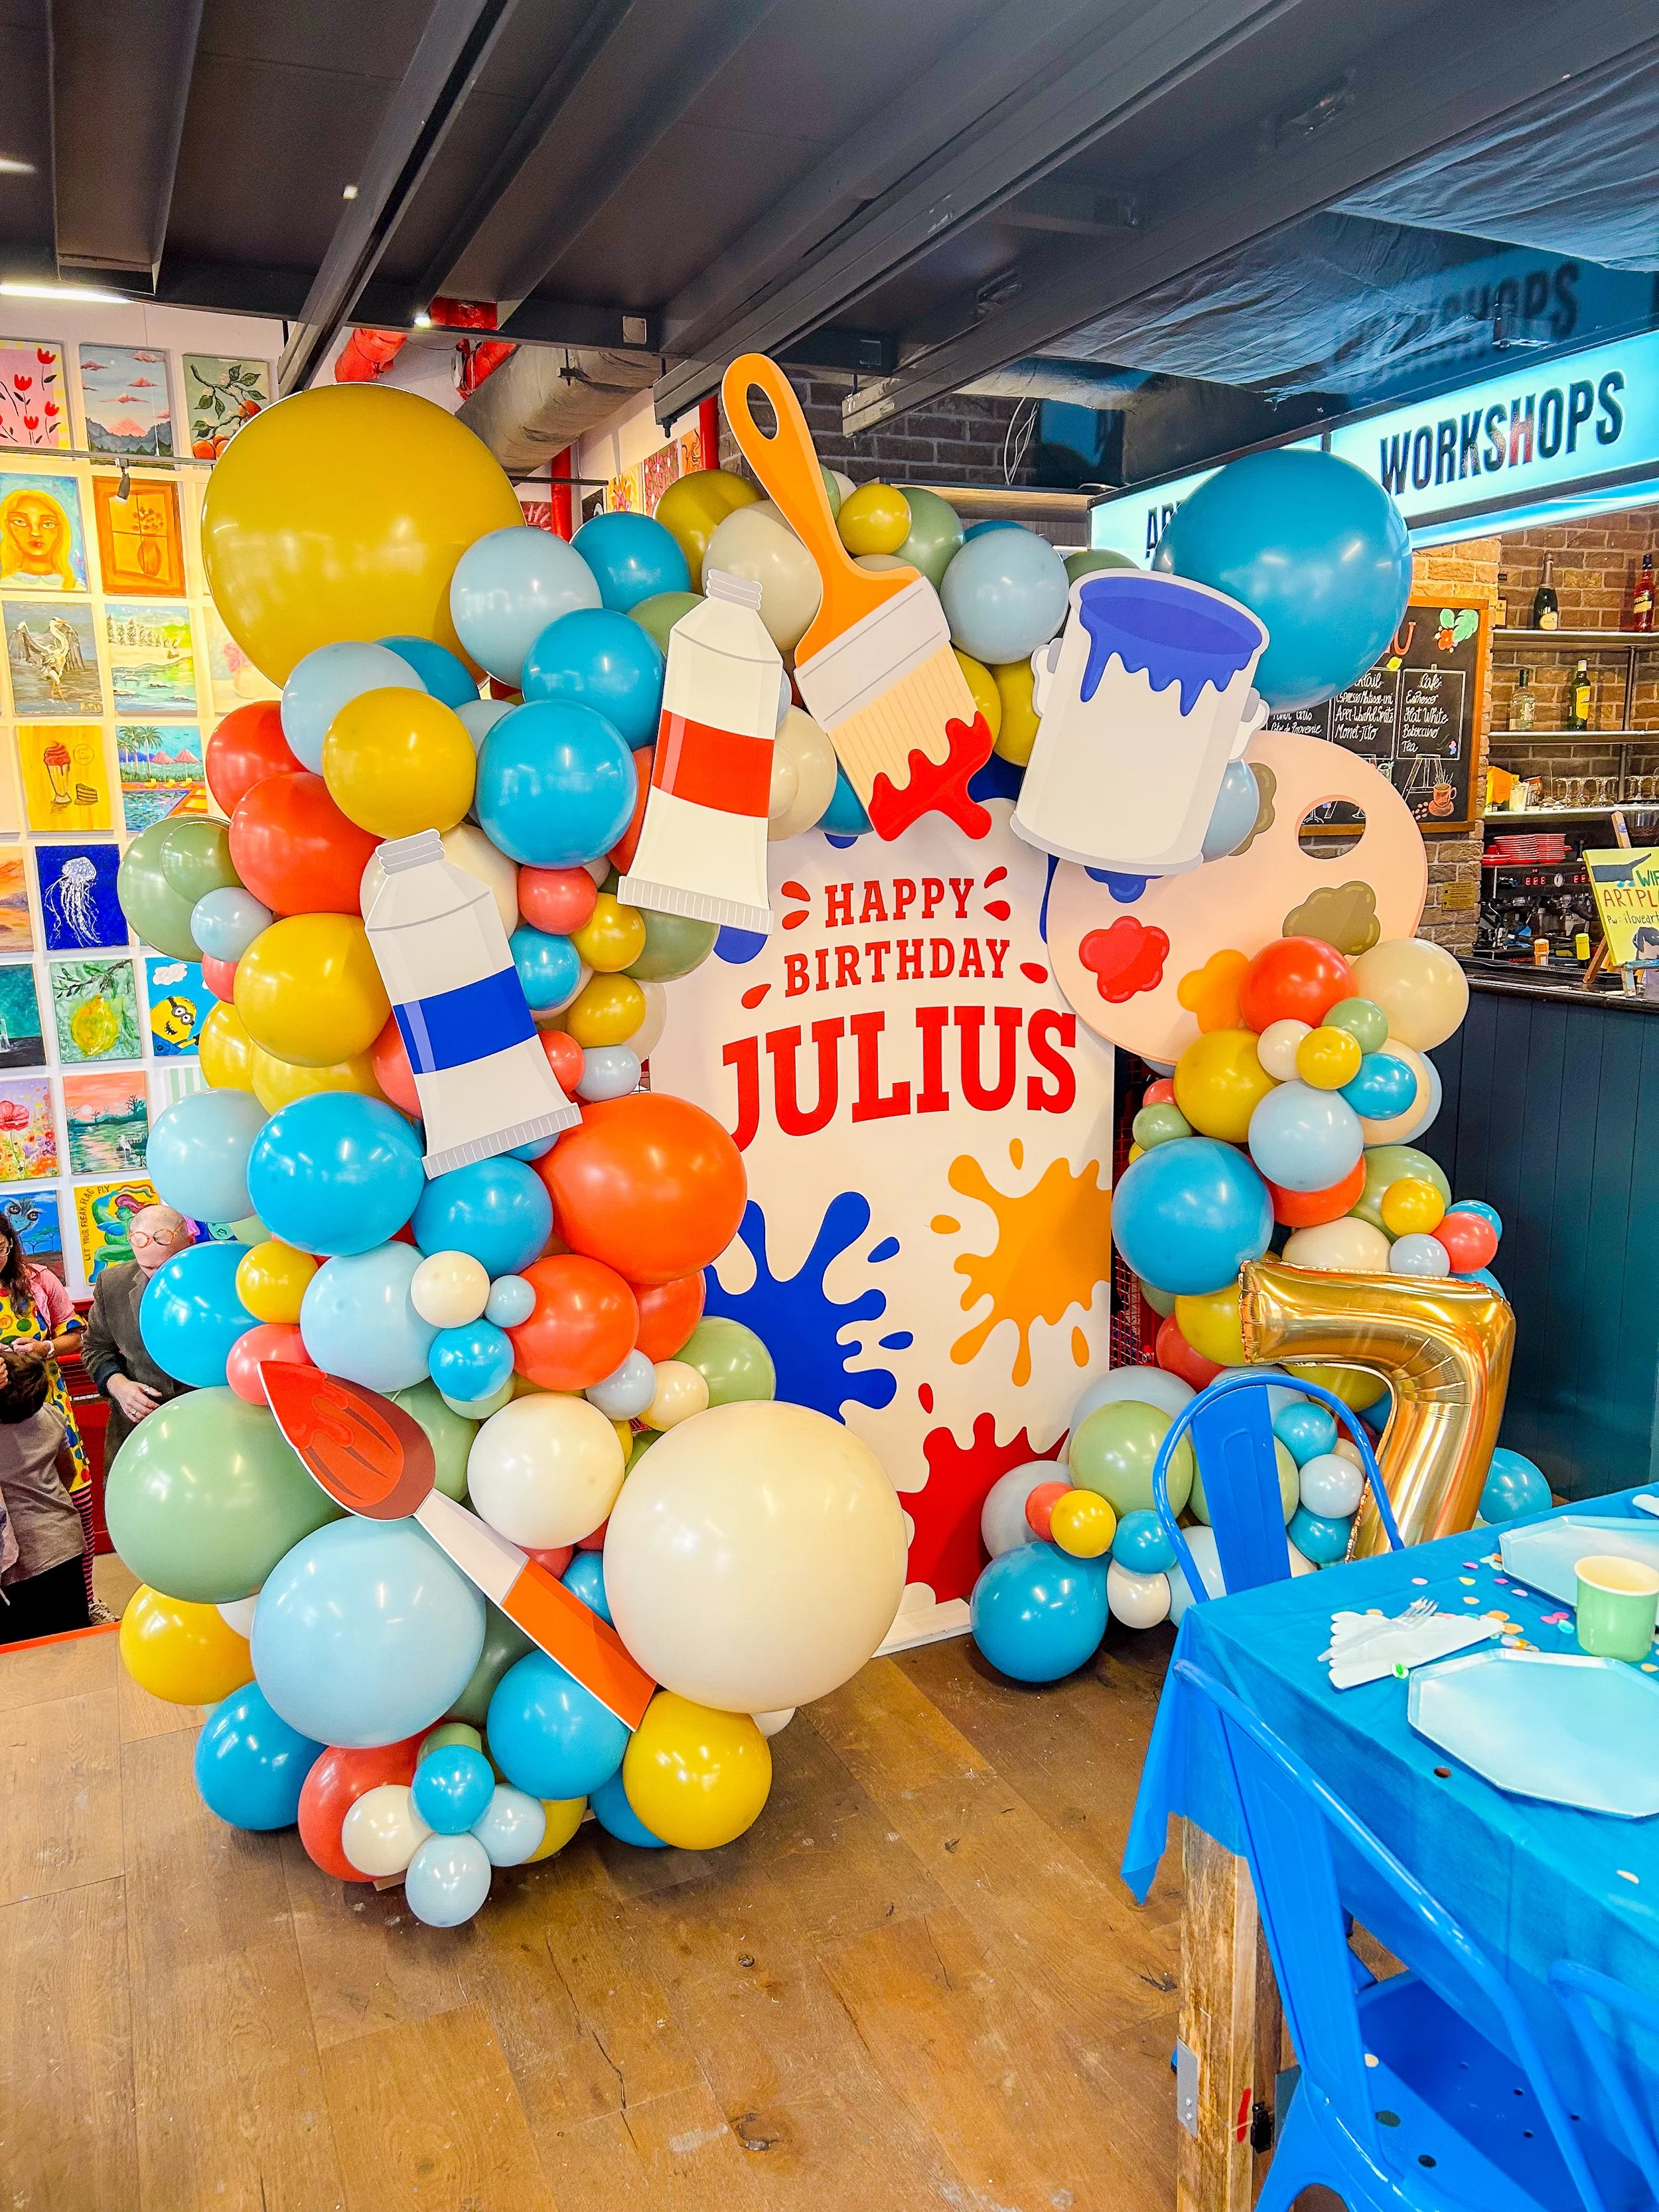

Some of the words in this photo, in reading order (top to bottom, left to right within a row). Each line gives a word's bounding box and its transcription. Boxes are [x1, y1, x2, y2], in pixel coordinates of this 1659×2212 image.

[1380, 370, 1626, 496] WORKSHOPS
[1423, 706, 1449, 725] White
[1401, 739, 1419, 753] Tea
[824, 877, 975, 928] HAPPY
[1603, 889, 1634, 907] ART
[1635, 889, 1659, 908] PL
[784, 937, 1011, 998] BIRTHDAY
[722, 1005, 1076, 1153] JULIUS
[80, 1188, 94, 1206] FLAG
[97, 1185, 110, 1195] FLY
[78, 1206, 88, 1228] FREAK
[81, 1228, 90, 1245] YOUR
